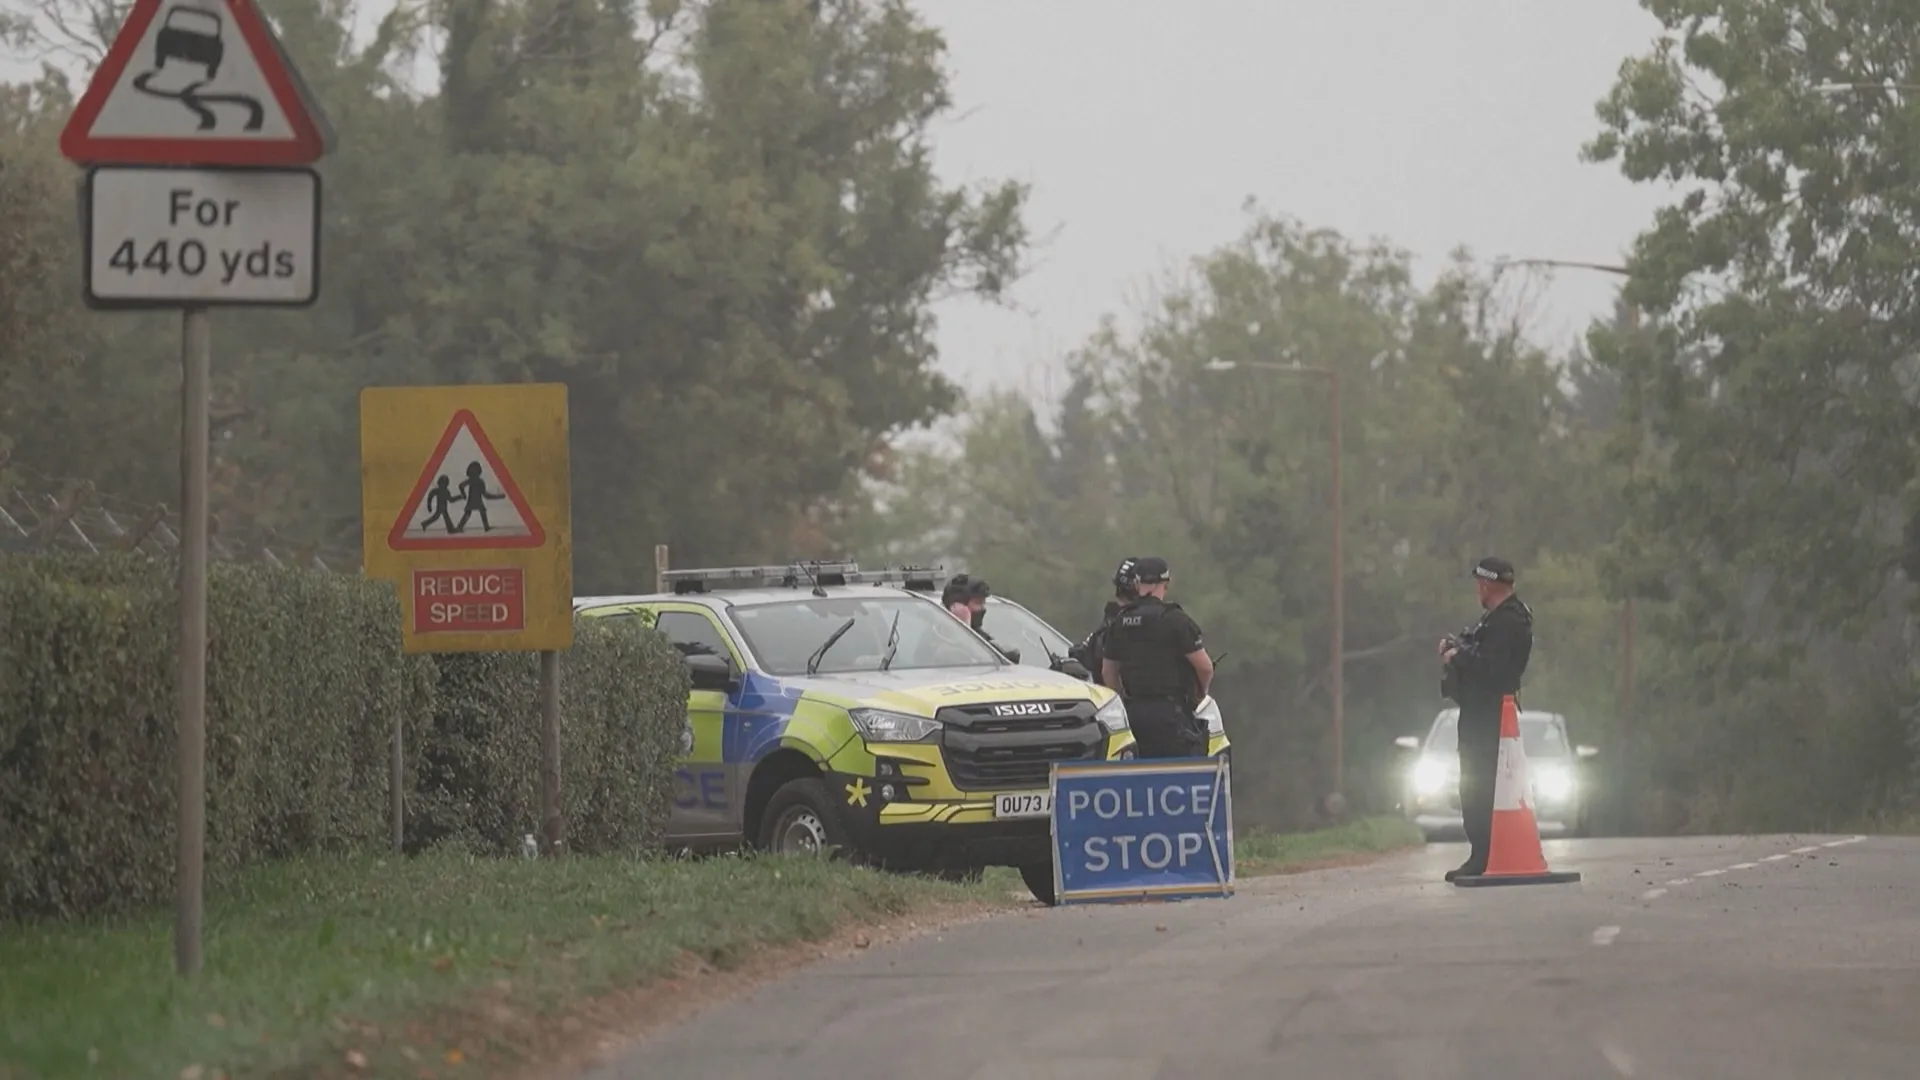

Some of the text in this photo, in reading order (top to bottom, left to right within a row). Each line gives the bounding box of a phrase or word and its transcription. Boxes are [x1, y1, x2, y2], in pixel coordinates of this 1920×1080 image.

[169, 188, 241, 227] For
[108, 238, 295, 285] 440 yds
[420, 574, 516, 597] REDUCE
[430, 602, 509, 624] SPEED
[994, 703, 1051, 716] ISUZU
[1002, 795, 1042, 813] OU73
[1068, 784, 1211, 821] POLICE
[1083, 832, 1203, 872] STOP
